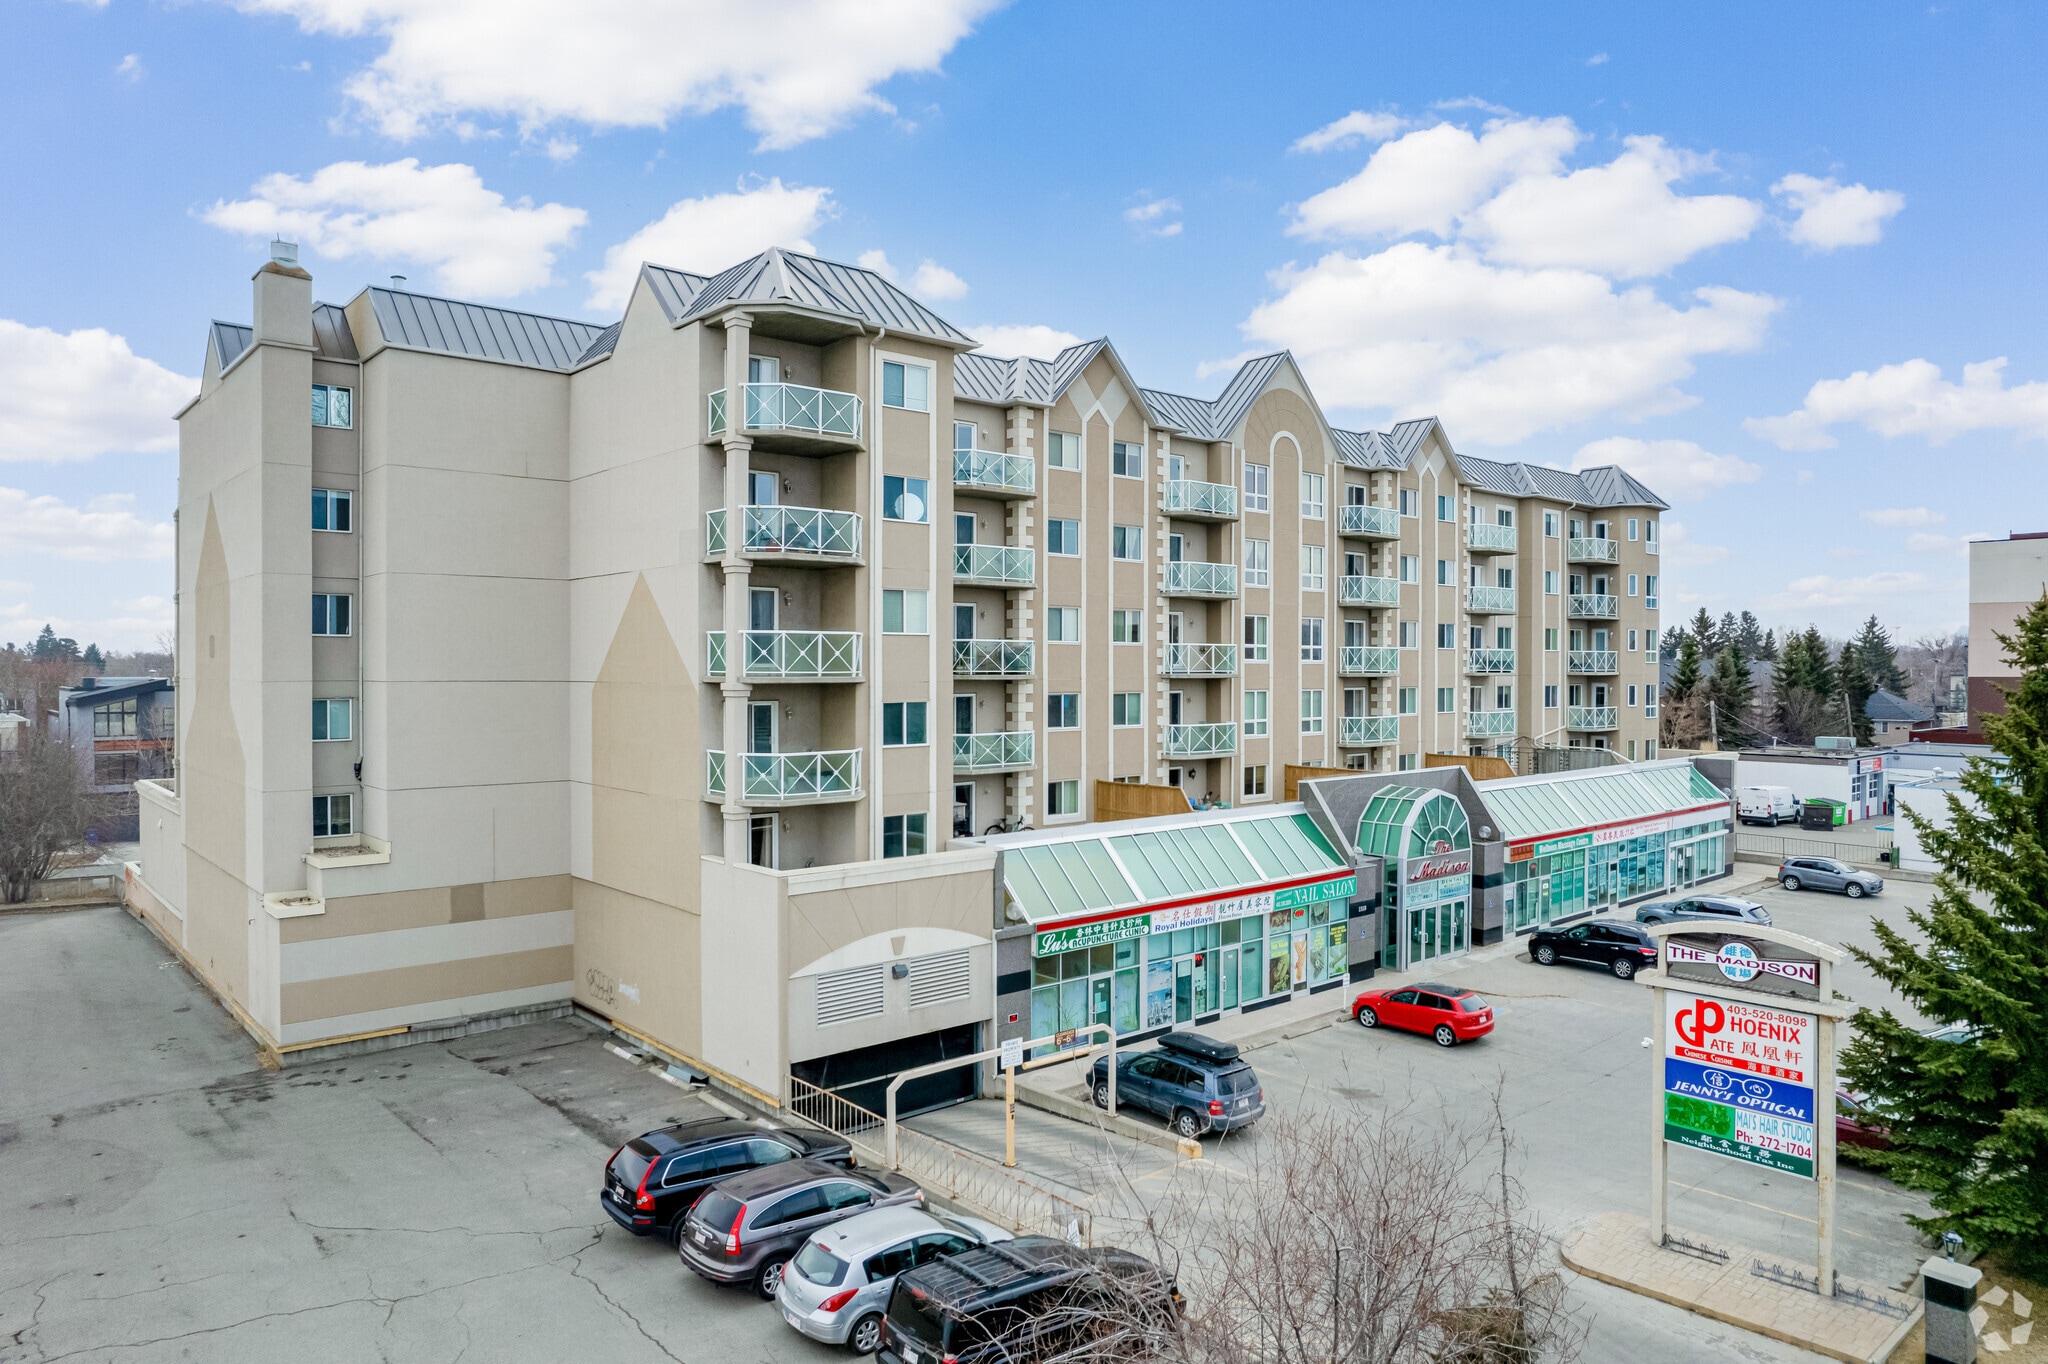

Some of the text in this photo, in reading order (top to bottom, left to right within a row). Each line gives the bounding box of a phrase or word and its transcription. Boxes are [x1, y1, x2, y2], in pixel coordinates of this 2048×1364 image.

[1414, 860, 1470, 880] Madison
[1293, 886, 1319, 905] NAIL
[1322, 879, 1356, 899] SALON
[1072, 926, 1146, 948] ACUPUNCTURE CLINIC
[1155, 915, 1213, 933] Royal Holidays
[1039, 931, 1069, 955] Lu's
[1669, 945, 1814, 980] THE MADISON
[1727, 1005, 1807, 1027] 403-520-8098
[1672, 1080, 1735, 1101] JENNY'S
[1737, 1095, 1807, 1119] OPTICAL
[1736, 1111, 1757, 1131] MAI'S
[1759, 1116, 1779, 1136] HAIR
[1781, 1121, 1812, 1144] STUDIO
[1681, 1136, 1795, 1171] Neighborhood Tax Inc
[1736, 1129, 1812, 1158] Ph: 272-1704
